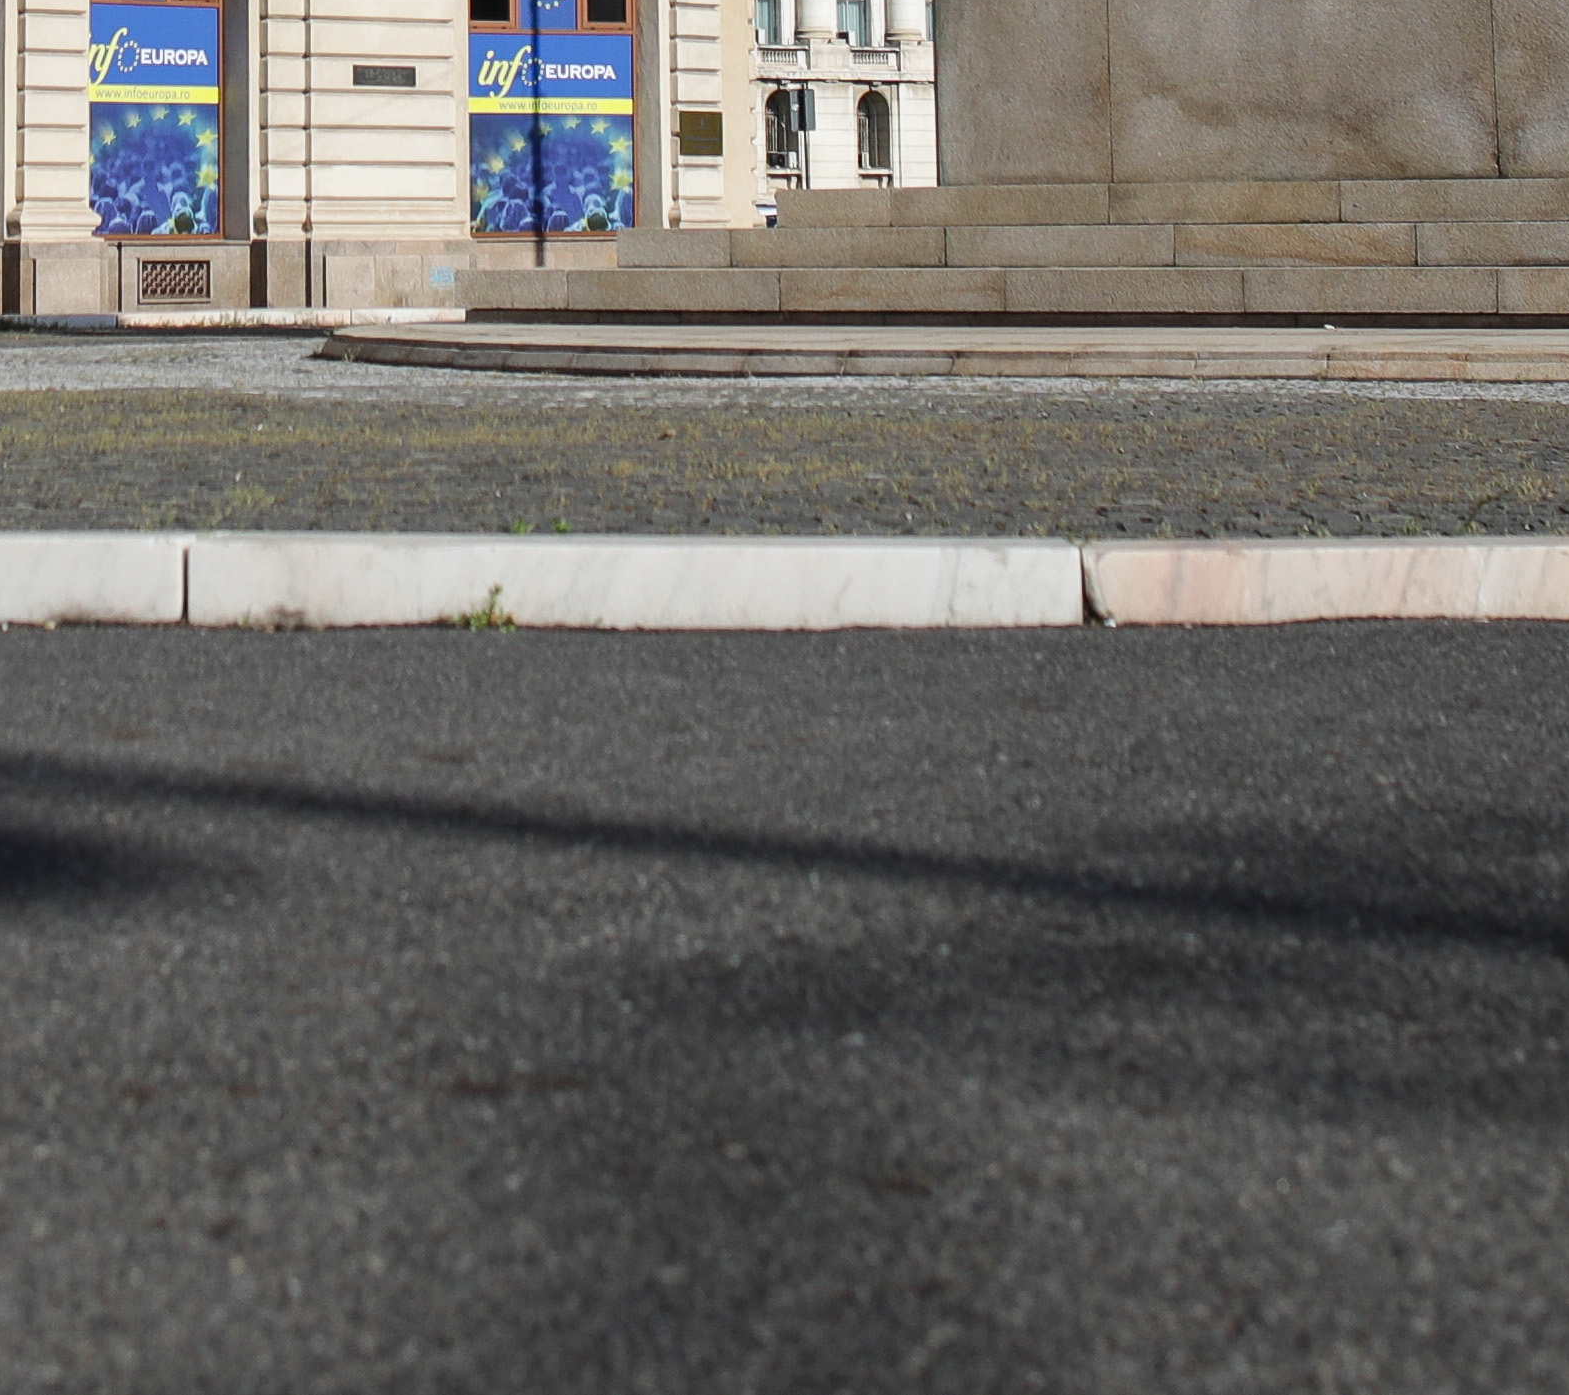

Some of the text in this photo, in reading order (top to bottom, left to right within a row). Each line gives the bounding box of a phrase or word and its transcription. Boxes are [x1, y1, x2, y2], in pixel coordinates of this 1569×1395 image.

[140, 47, 209, 66] EUROPA
[545, 63, 617, 81] EUROPA
[95, 86, 191, 102] www.infoeuropa.ro
[498, 99, 598, 113] www.infoeuropa.ro
